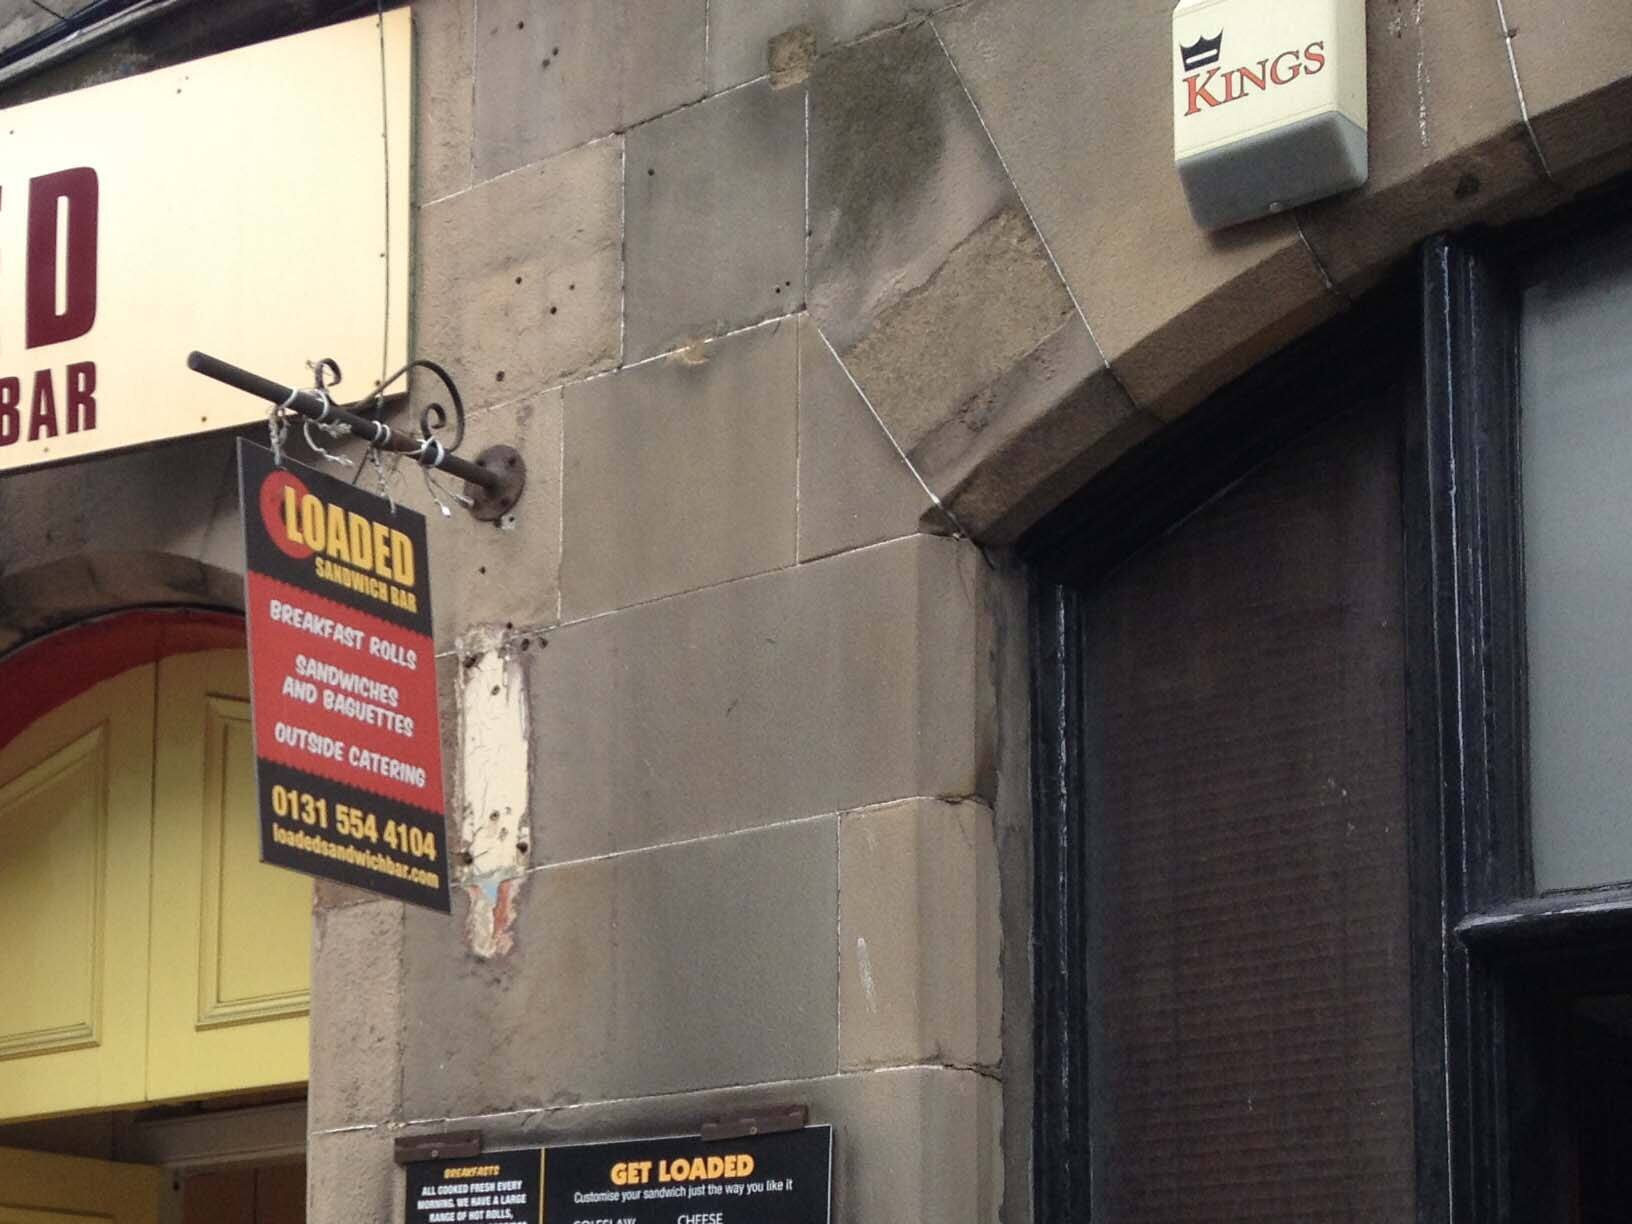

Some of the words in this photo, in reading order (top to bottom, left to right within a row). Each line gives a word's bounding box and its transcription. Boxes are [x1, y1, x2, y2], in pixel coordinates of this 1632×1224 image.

[1183, 40, 1326, 116] KINGS
[284, 486, 415, 587] LOADED
[315, 557, 389, 603] SANDWICH
[390, 587, 417, 613] BAR
[270, 600, 364, 650] BREAKFAST
[370, 637, 416, 670] ROLLS
[282, 676, 317, 704] AND
[323, 689, 414, 738] BAGUETTES
[295, 657, 399, 707] SANDWICHES
[274, 722, 345, 761] OUTSIDE
[348, 743, 426, 788] CATERING
[272, 785, 328, 829] 0131
[335, 804, 378, 844] 554
[383, 819, 436, 861] 4104
[273, 823, 440, 888] loadedsandwichbar.com
[574, 1190, 619, 1203] Customise
[622, 1190, 641, 1203] your
[643, 1185, 686, 1199] sandwich
[688, 1184, 705, 1199] just
[708, 1183, 722, 1195] the
[725, 1184, 744, 1196] way
[747, 1182, 764, 1195] you
[766, 1180, 783, 1191] like
[785, 1179, 792, 1190] it
[611, 1161, 652, 1185] GET
[658, 1155, 755, 1182] LOADED
